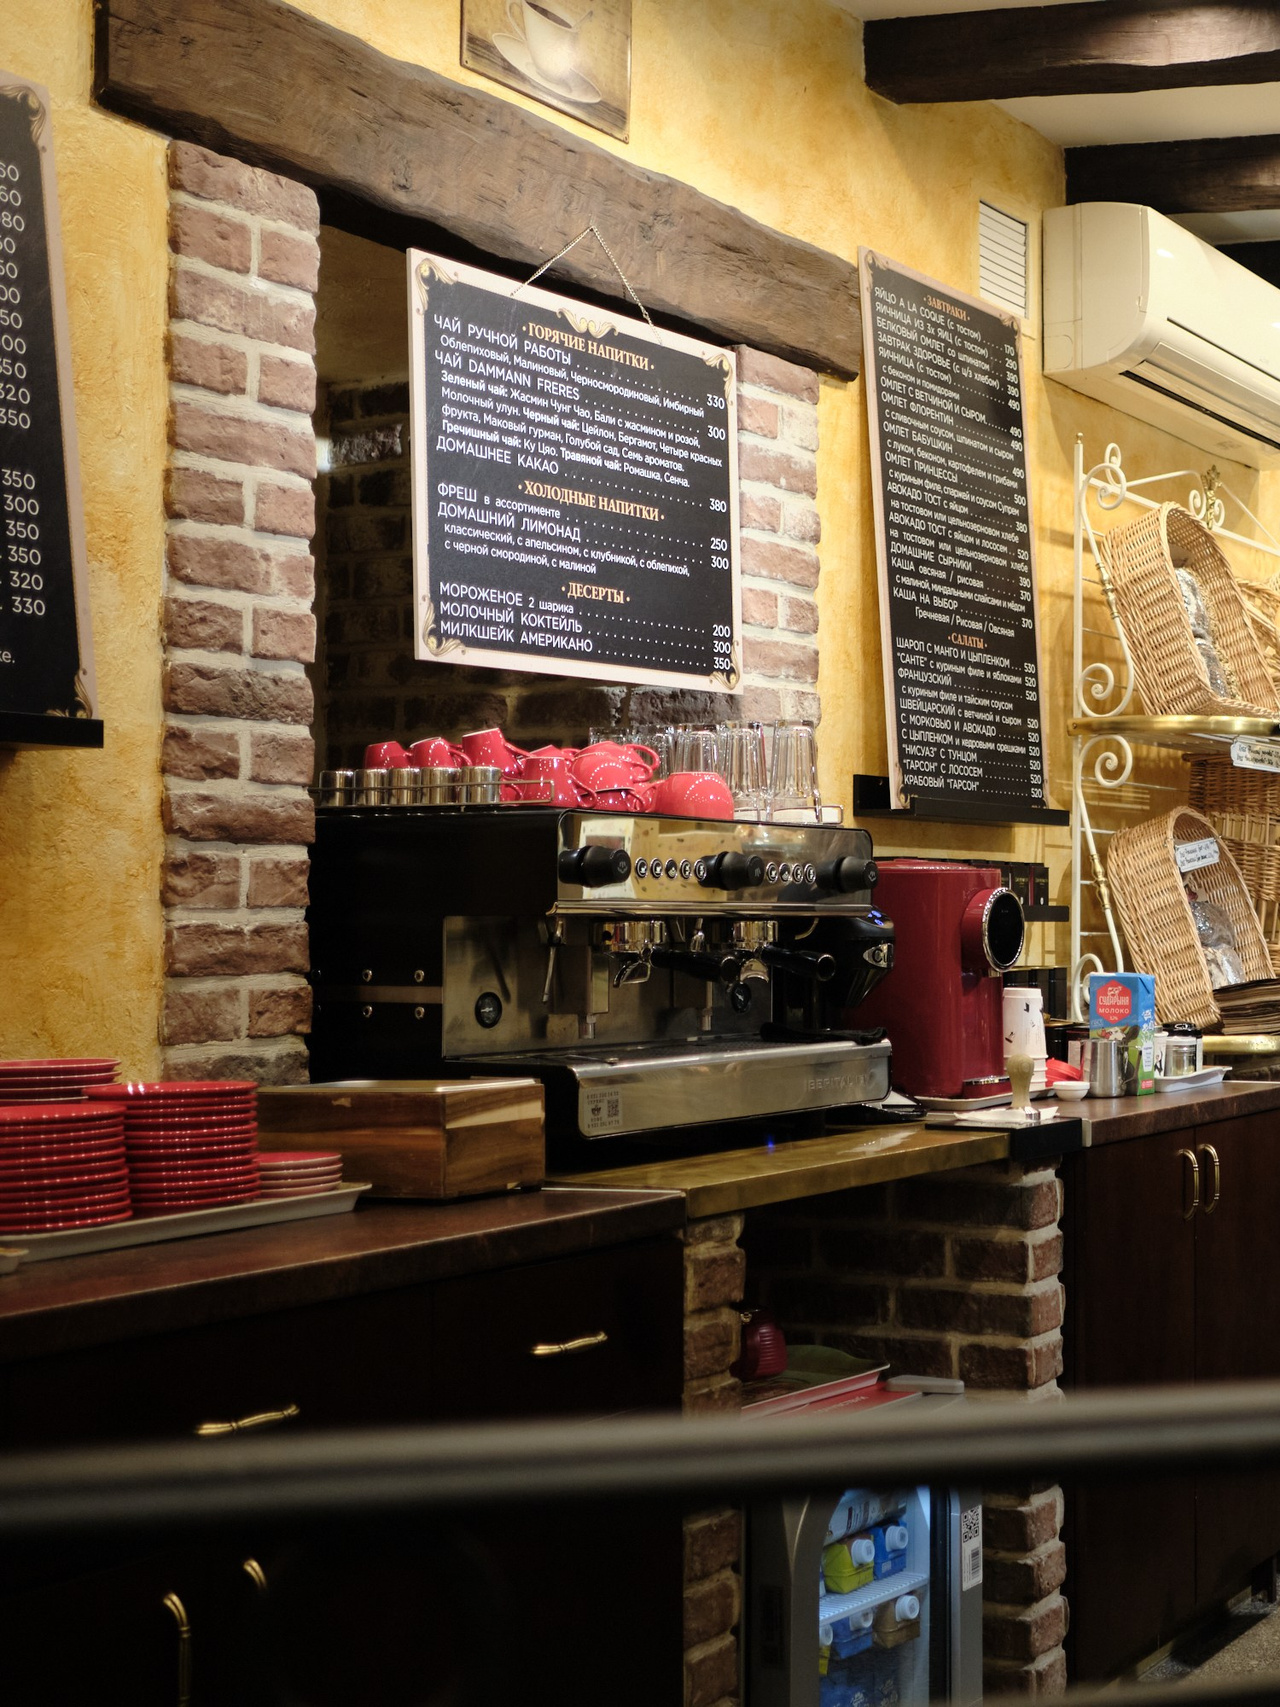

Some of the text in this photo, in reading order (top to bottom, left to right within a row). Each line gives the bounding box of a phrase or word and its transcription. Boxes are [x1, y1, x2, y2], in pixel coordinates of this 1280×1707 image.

[874, 286, 896, 304] ЯЙЦО
[919, 305, 945, 326] COQUE
[955, 323, 981, 342] тостом)
[1003, 343, 1015, 356] 170
[926, 294, 966, 321] ЗАВТРАКИ
[433, 313, 725, 410] ЧАЙ РУЧНОЙ РАБОТЫ 330
[528, 321, 648, 371] ГОРЯЧИЕ НАПИТКИ
[876, 315, 918, 342] БЕЛКОВЫЙ
[919, 334, 945, 353] ОМЛЕТ
[957, 351, 990, 371] шпинатом
[1005, 370, 1018, 384] 390
[434, 349, 726, 441] ЧАЙ DAMMANN FRERES 300
[439, 333, 704, 418] Облепиховый, Малиновый, Черносмородиновый, Имбирный
[440, 369, 700, 449] Зеленый чай: Жасмин Чунг Чао, Бали с жасмином и розой,
[441, 385, 494, 410] Молочный
[495, 401, 521, 417] улун.
[522, 406, 560, 426] Черный
[560, 417, 580, 431] чай:
[581, 421, 616, 442] Цейлон,
[617, 430, 658, 452] Бергамот,
[658, 440, 689, 459] Четыре
[880, 390, 1023, 452] ОМЛЕТ ФЛОРЕНТИН 490
[441, 402, 481, 424] фрукта,
[483, 412, 527, 434] Маковый
[528, 425, 563, 444] гурман,
[564, 432, 601, 452] Голубой
[621, 446, 643, 462] Семь
[643, 453, 684, 472] ароматов.
[441, 418, 500, 443] Гречишный
[501, 434, 522, 448] чай:
[523, 437, 536, 453] Ку
[559, 446, 603, 467] Травяной
[603, 458, 622, 472] чай:
[622, 461, 663, 482] Ромашка,
[663, 471, 690, 488] Сенча.
[1, 468, 36, 490] 350
[435, 434, 727, 513] ДОМАШНЕЕ КАКАО 380
[884, 450, 1026, 506] ОМЛЕТ ПРИНЦЕССЫ 500
[3, 494, 40, 516] 300
[437, 481, 728, 552] ФРЕШ в ассортименте 250
[523, 479, 659, 522] ХОЛОДНЫЕ НАПИТКИ
[5, 519, 40, 541] 350
[437, 500, 729, 570] ДОМАШНИЙ ЛИМОНАД 300
[443, 523, 690, 577] классический, с апельсином, с клубникой, с облепихой,
[7, 545, 42, 566] 350
[9, 570, 44, 591] 320
[443, 539, 596, 574] с черной смородиной, с малиной
[889, 540, 1031, 588] ДОМАШНИЕ СЫРНИКИ 390
[11, 596, 46, 616] 330
[439, 581, 730, 638] МОРОЖЕНОЕ 2 шарика 200
[566, 581, 624, 604] ДЕСЕРТЫ
[892, 586, 917, 601] КАША
[932, 595, 958, 610] ВЫБОР
[1020, 617, 1033, 629] 370
[439, 600, 730, 654] МОЛОЧНЫЙ КОКТЕЙЛЬ 300
[440, 619, 730, 670] МИЛКШЕЙК АМЕРИКАНО 350
[950, 632, 984, 649] САЛАТЫ
[897, 666, 1037, 701] ФРАНЦУЗСКИЙ 520
[933, 643, 959, 659] МАНГО
[967, 650, 1010, 668] ЦЫПЛЕНКОМ
[1023, 662, 1035, 674] 530
[947, 748, 977, 763] ТУНЦОМ
[1029, 759, 1041, 770] 520
[947, 763, 983, 777] ЛОСОСЕМ
[1029, 773, 1041, 784] 520
[903, 773, 944, 788] КРАБОВЫЙ
[1030, 787, 1043, 799] 520
